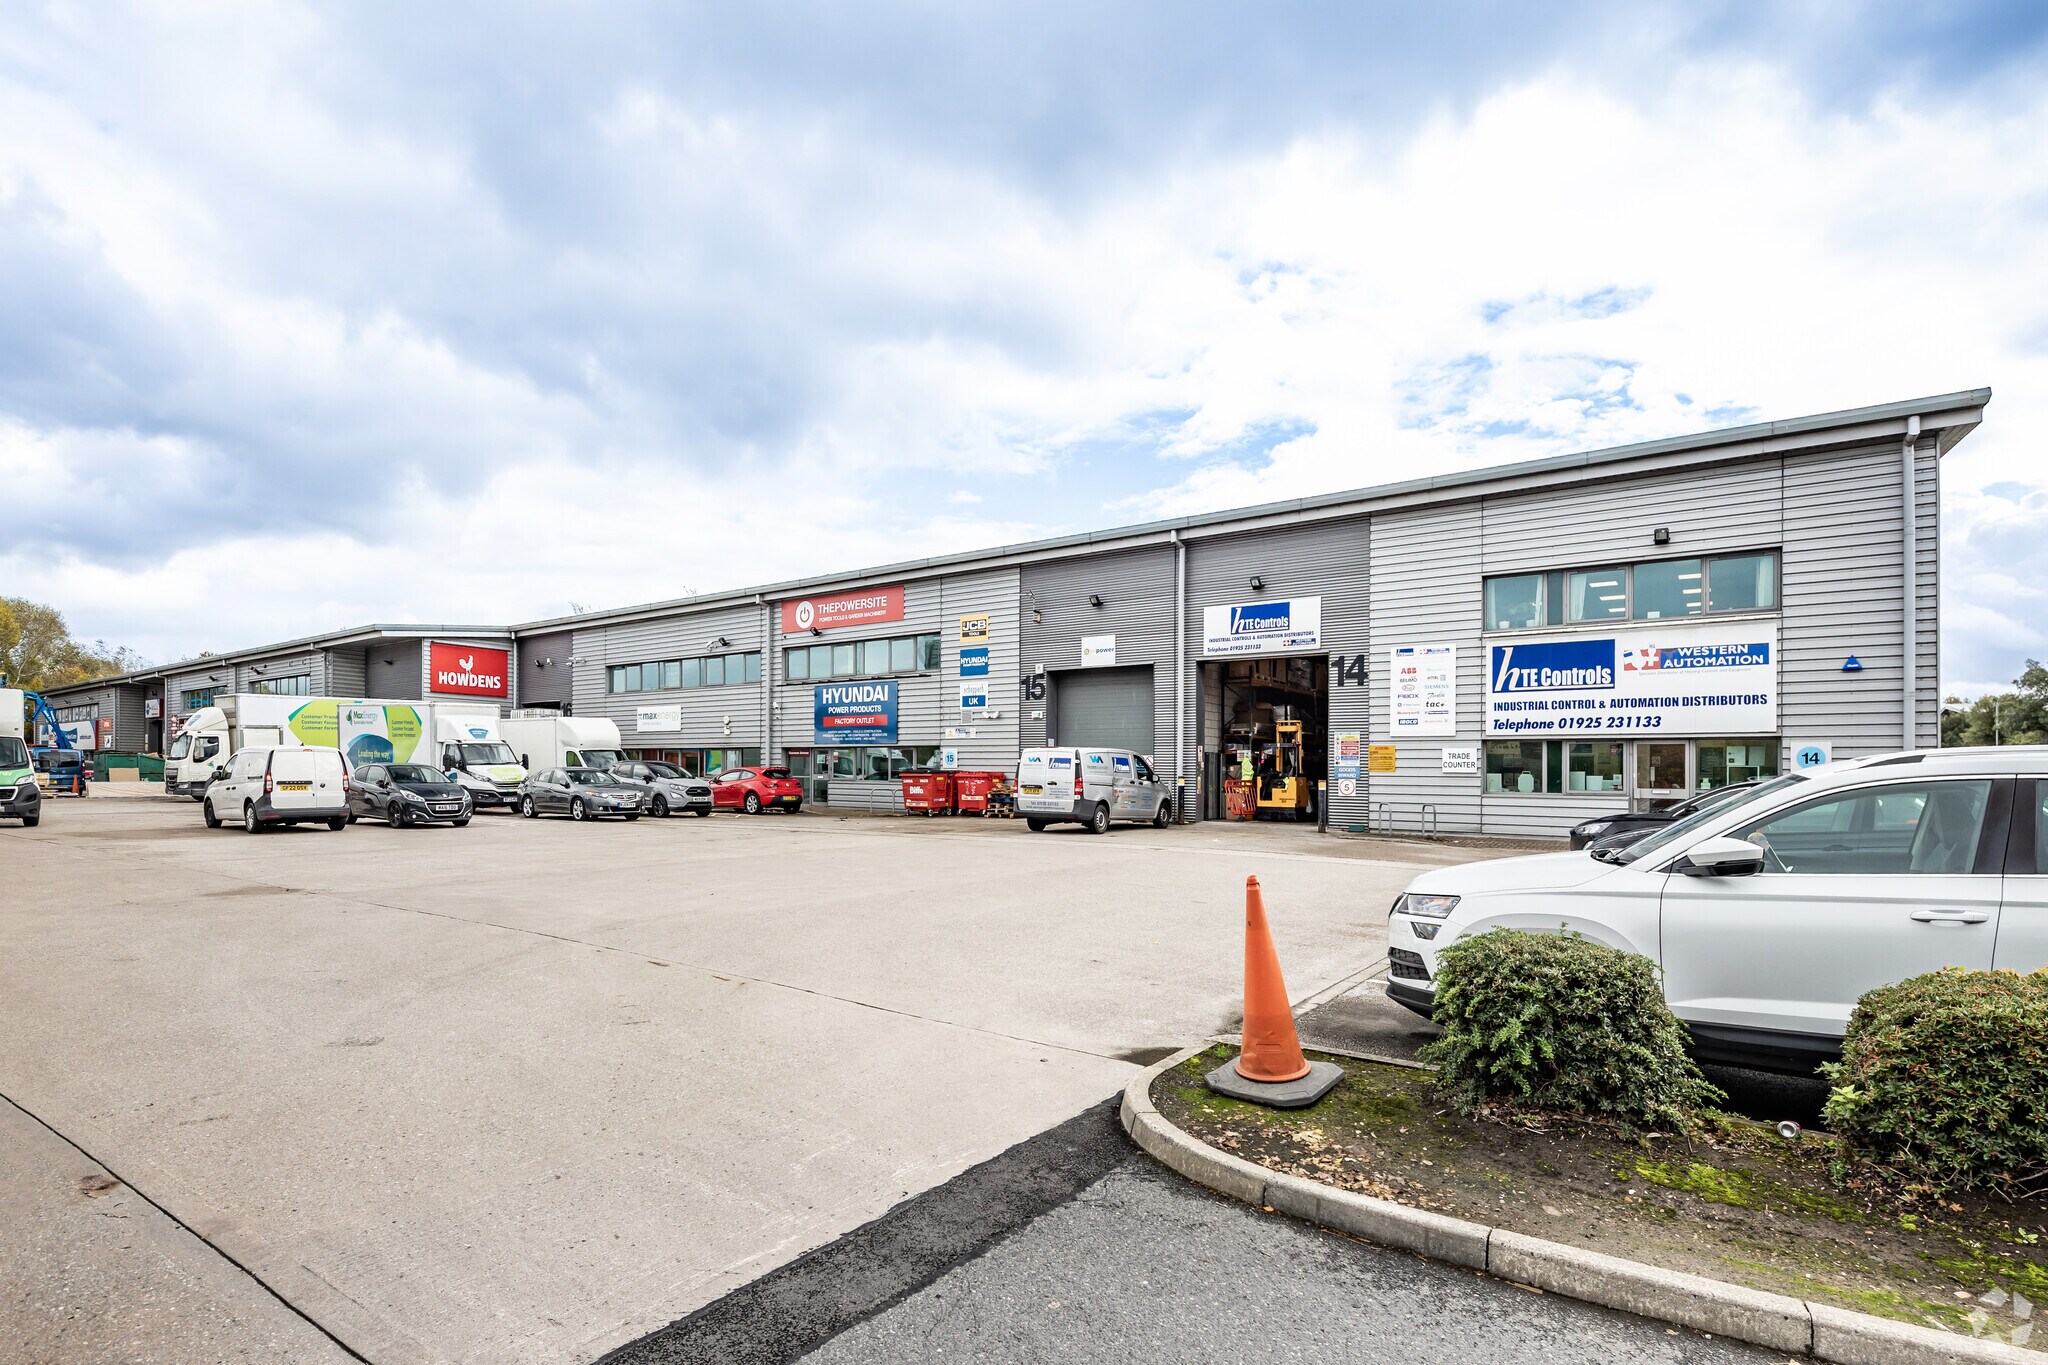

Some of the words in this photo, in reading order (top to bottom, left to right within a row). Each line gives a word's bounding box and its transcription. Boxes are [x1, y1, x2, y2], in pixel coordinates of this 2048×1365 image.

[818, 596, 887, 614] THEPOWERSITE
[962, 620, 986, 630] JCB
[1254, 616, 1289, 629] Controls
[1677, 643, 1748, 657] WESTERN
[960, 656, 988, 665] HYUNDAI
[1663, 654, 1764, 668] AUTOMATION
[1330, 654, 1369, 687] 14
[1541, 665, 1612, 687] Controls
[438, 671, 501, 689] HOWDENS
[1020, 674, 1046, 700] 15
[822, 684, 889, 704] HYUNDAI
[968, 697, 979, 705] UK
[1493, 701, 1549, 711] INDUSTRIAL
[1551, 699, 1596, 710] CONTROL
[1599, 700, 1606, 709] &
[1610, 697, 1679, 709] AUTOMATION
[1681, 694, 1768, 707] DISTRIBUTORS
[828, 706, 849, 714] POWER
[850, 705, 882, 713] PRODUCTS
[1493, 718, 1554, 733] Telephone
[1558, 717, 1602, 729] 01925
[1606, 715, 1662, 728] 231133
[357, 749, 374, 760] Leading
[946, 754, 954, 762] 15
[1801, 752, 1820, 765] 14
[909, 786, 924, 794] Biffa
[1344, 784, 1350, 792] 5
